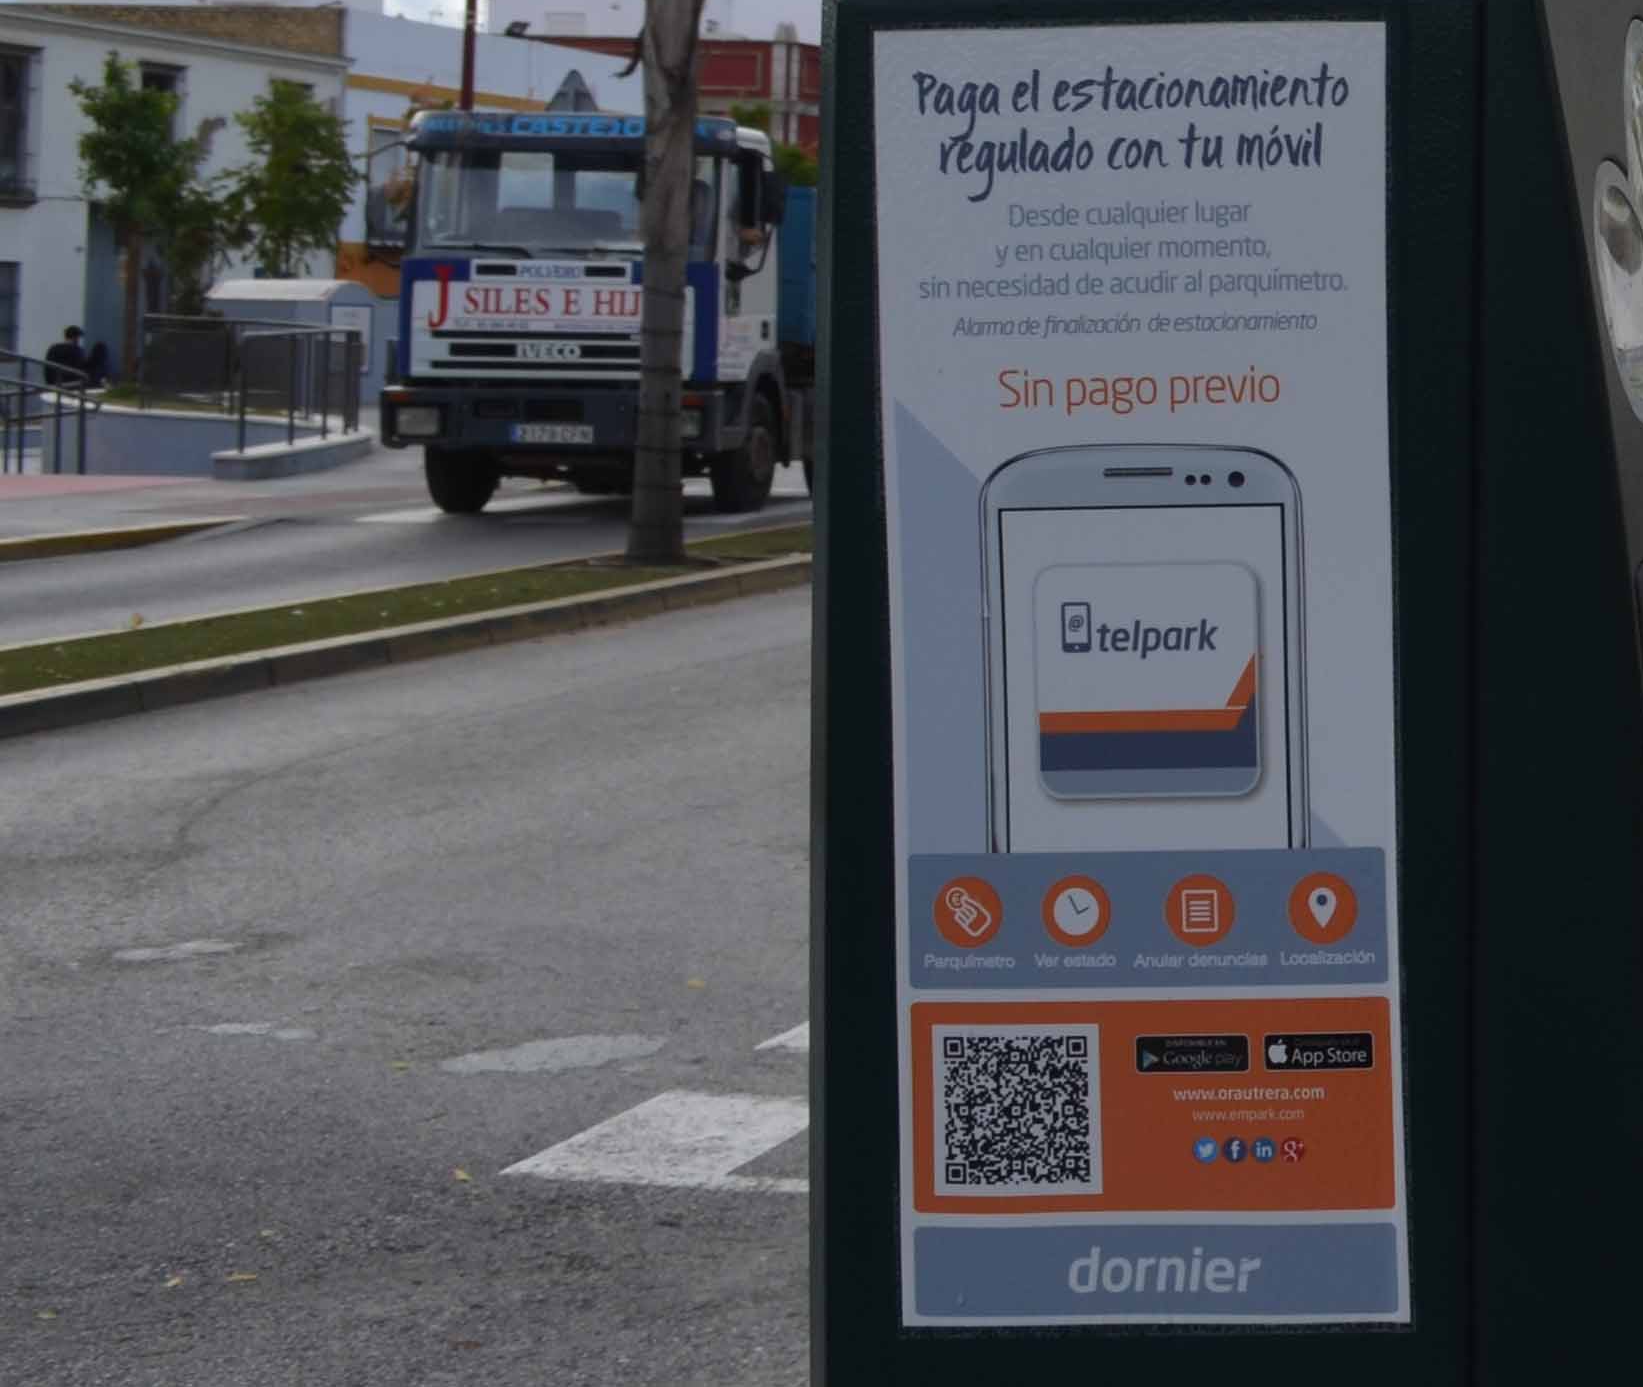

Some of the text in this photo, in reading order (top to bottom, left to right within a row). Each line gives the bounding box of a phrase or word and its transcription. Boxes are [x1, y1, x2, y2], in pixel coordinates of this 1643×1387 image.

[912, 61, 1349, 142] Paga el estacionamiento
[939, 121, 1324, 203] regulado con tu móvil
[1008, 198, 1252, 229] Desde cualquier lugar
[994, 236, 1272, 268] y en cualquier momento,
[428, 265, 455, 329] J
[463, 287, 552, 316] SILES
[561, 287, 584, 317] E
[592, 289, 641, 317] HIJ
[918, 266, 1349, 300] sin necesidad de acudir al parquímetro.
[952, 311, 1319, 339] Alarma de finalización de estacionamiento
[516, 342, 582, 359] IVECO
[998, 364, 1281, 417] Sin pago previo
[1096, 618, 1219, 659] telpark
[923, 951, 1016, 972] Parquímetro
[1034, 952, 1117, 968] Ver estado
[1133, 952, 1268, 969] Anular denuncias
[1279, 948, 1376, 968] Localización
[1162, 1048, 1211, 1070] Google
[1291, 1046, 1367, 1068] App Store
[1172, 1086, 1325, 1102] www.orautrera.com
[1192, 1107, 1305, 1123] www.empark.com
[1067, 1245, 1262, 1294] dornier
